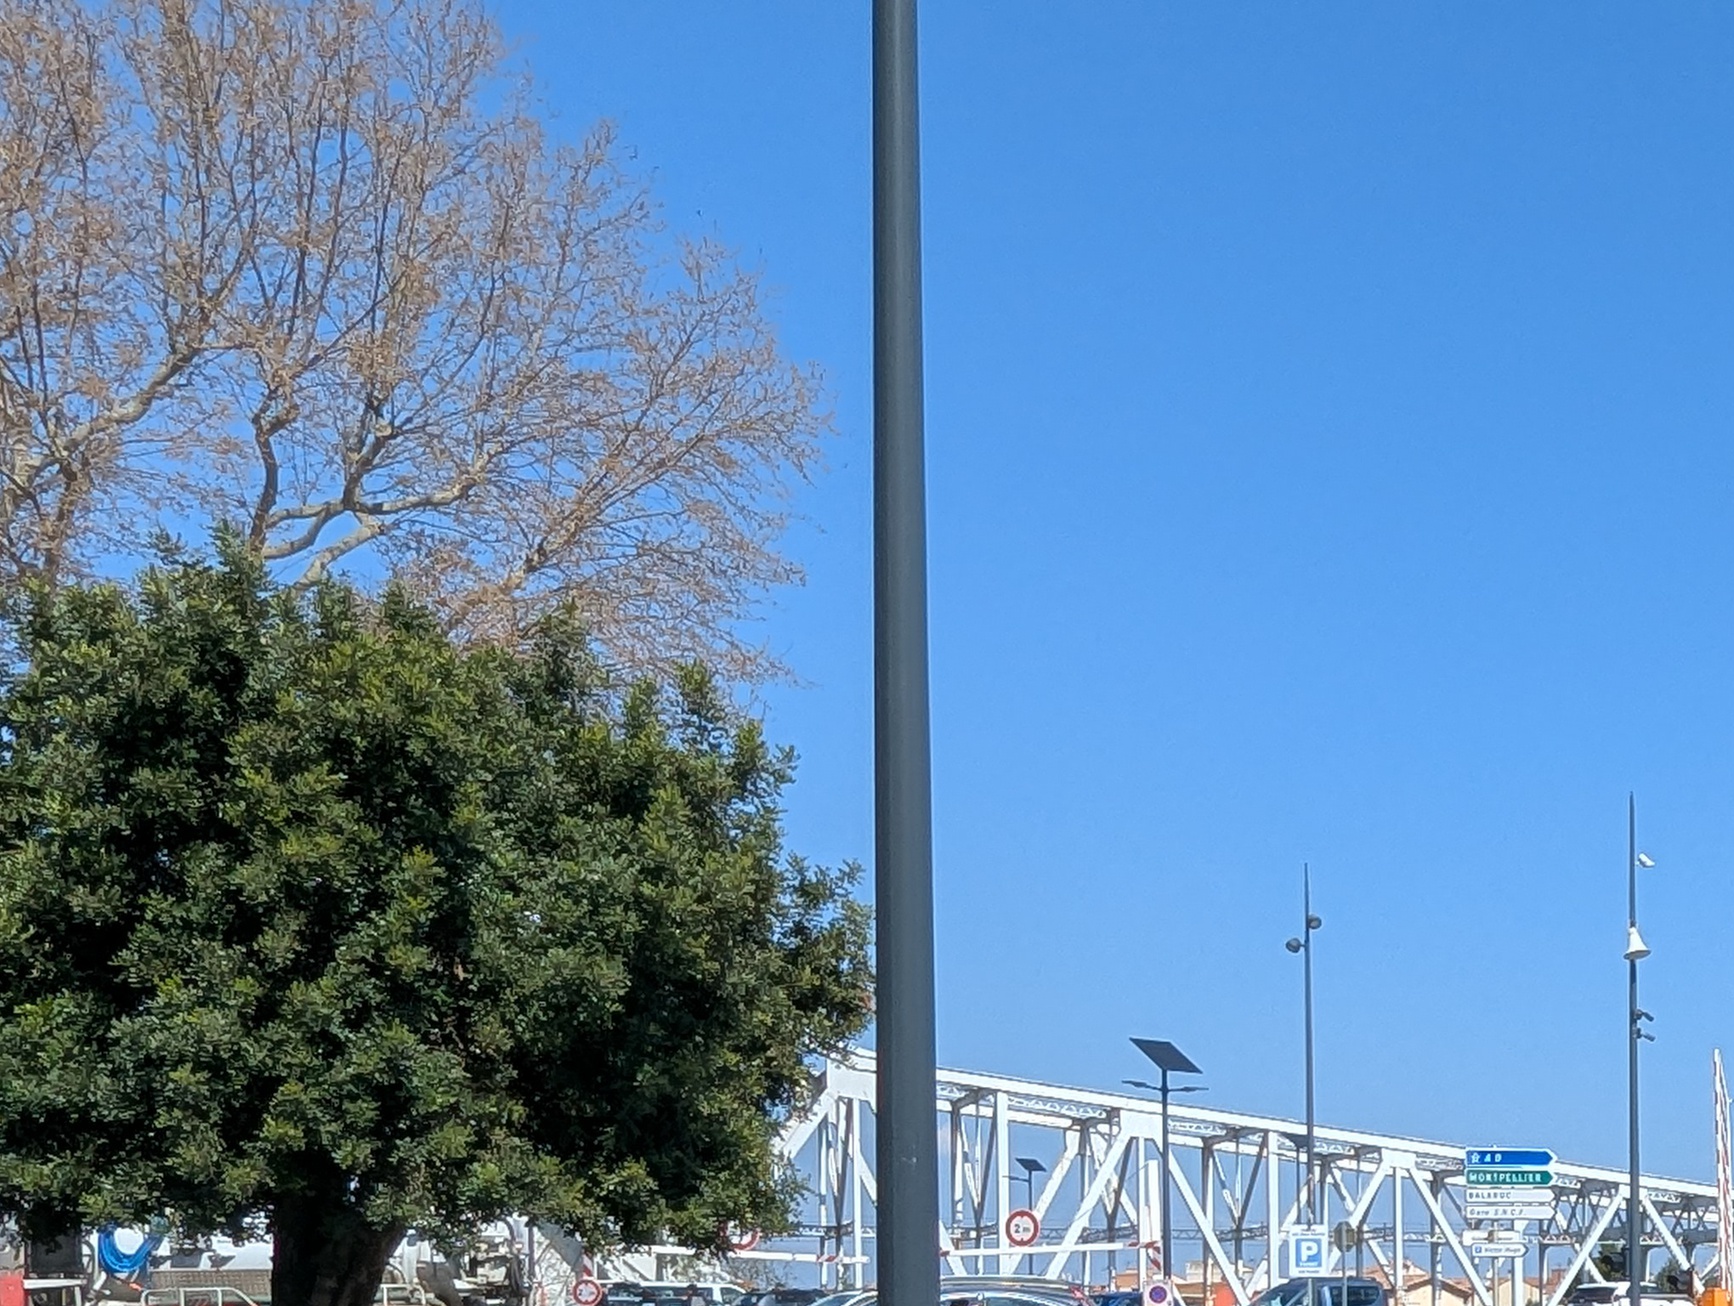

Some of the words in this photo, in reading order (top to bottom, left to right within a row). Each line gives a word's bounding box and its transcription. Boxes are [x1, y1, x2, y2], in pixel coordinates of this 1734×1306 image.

[1468, 1171, 1542, 1183] MONTPELLIER
[1468, 1190, 1512, 1200] BALARUC
[1469, 1208, 1490, 1217] Gare
[1014, 1223, 1021, 1234] 2
